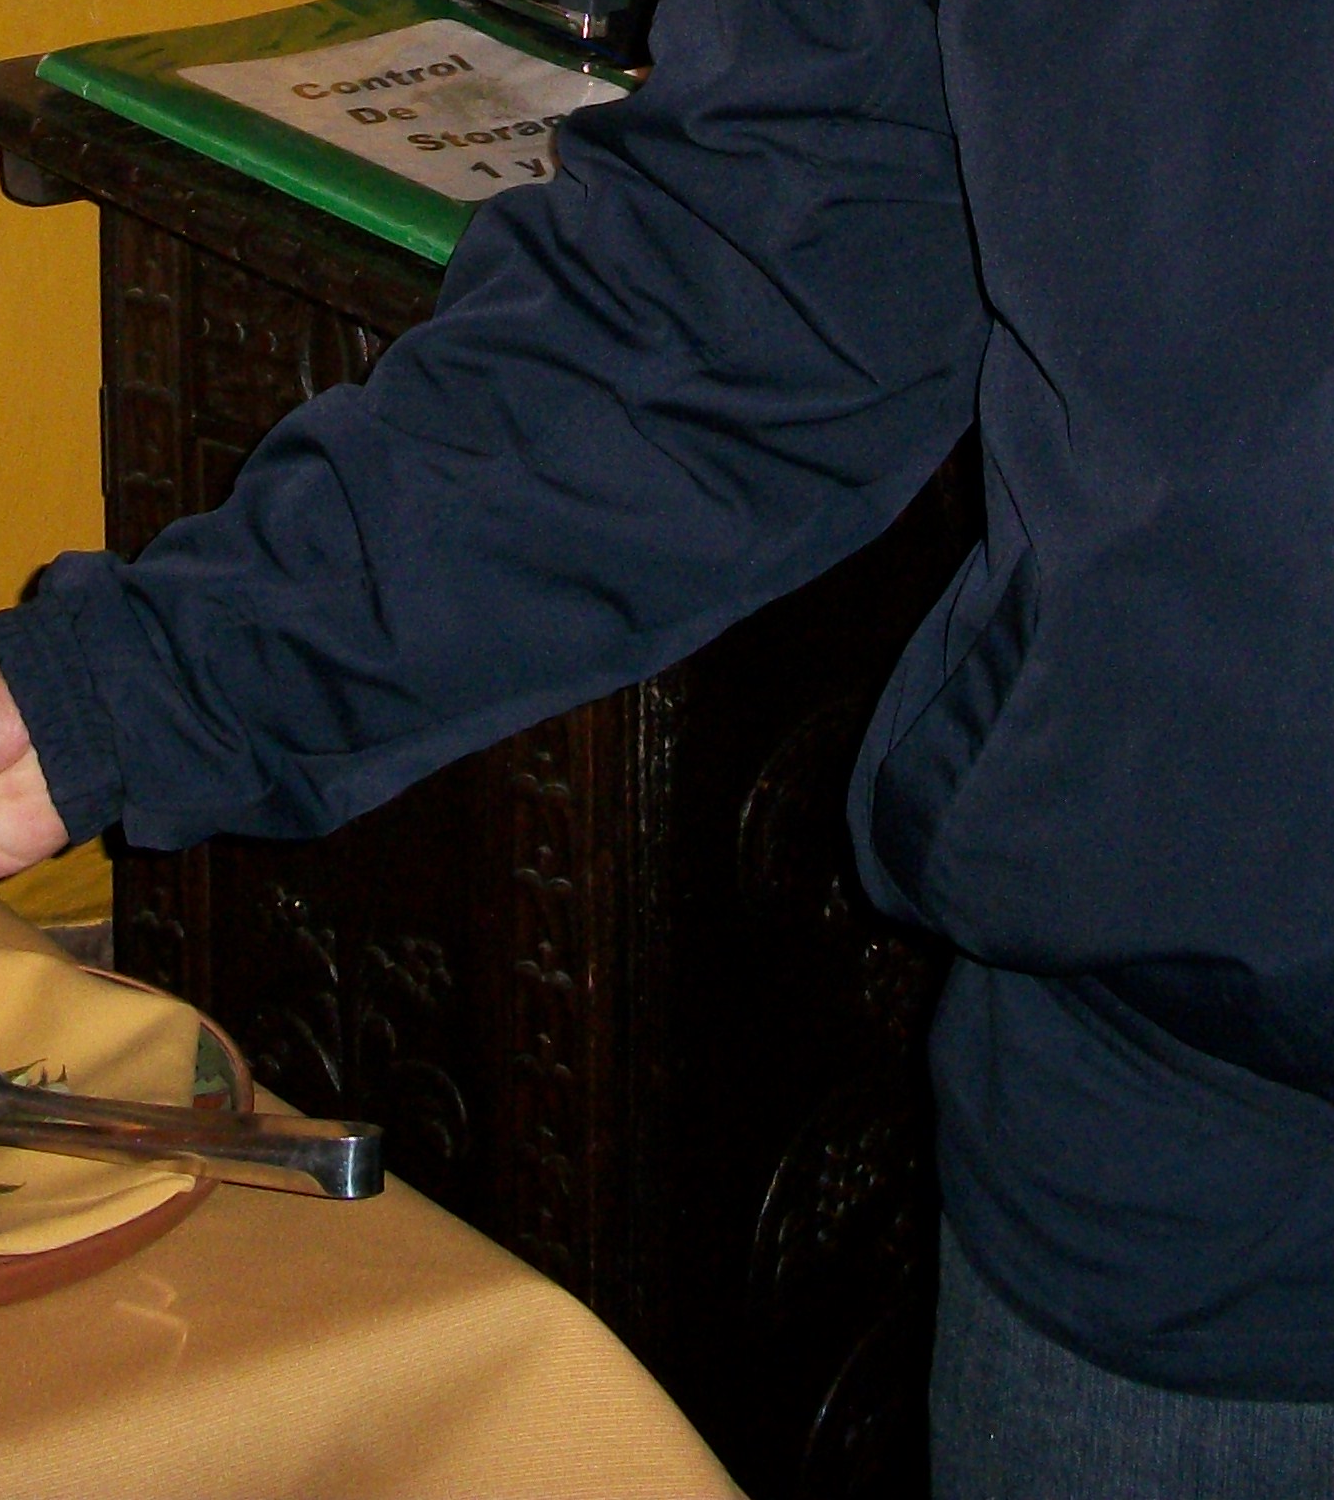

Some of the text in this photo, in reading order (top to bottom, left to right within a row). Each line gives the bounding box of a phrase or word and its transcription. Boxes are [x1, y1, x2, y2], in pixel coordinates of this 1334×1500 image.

[291, 53, 475, 100] Control
[347, 105, 419, 125] De
[471, 160, 502, 179] 1
